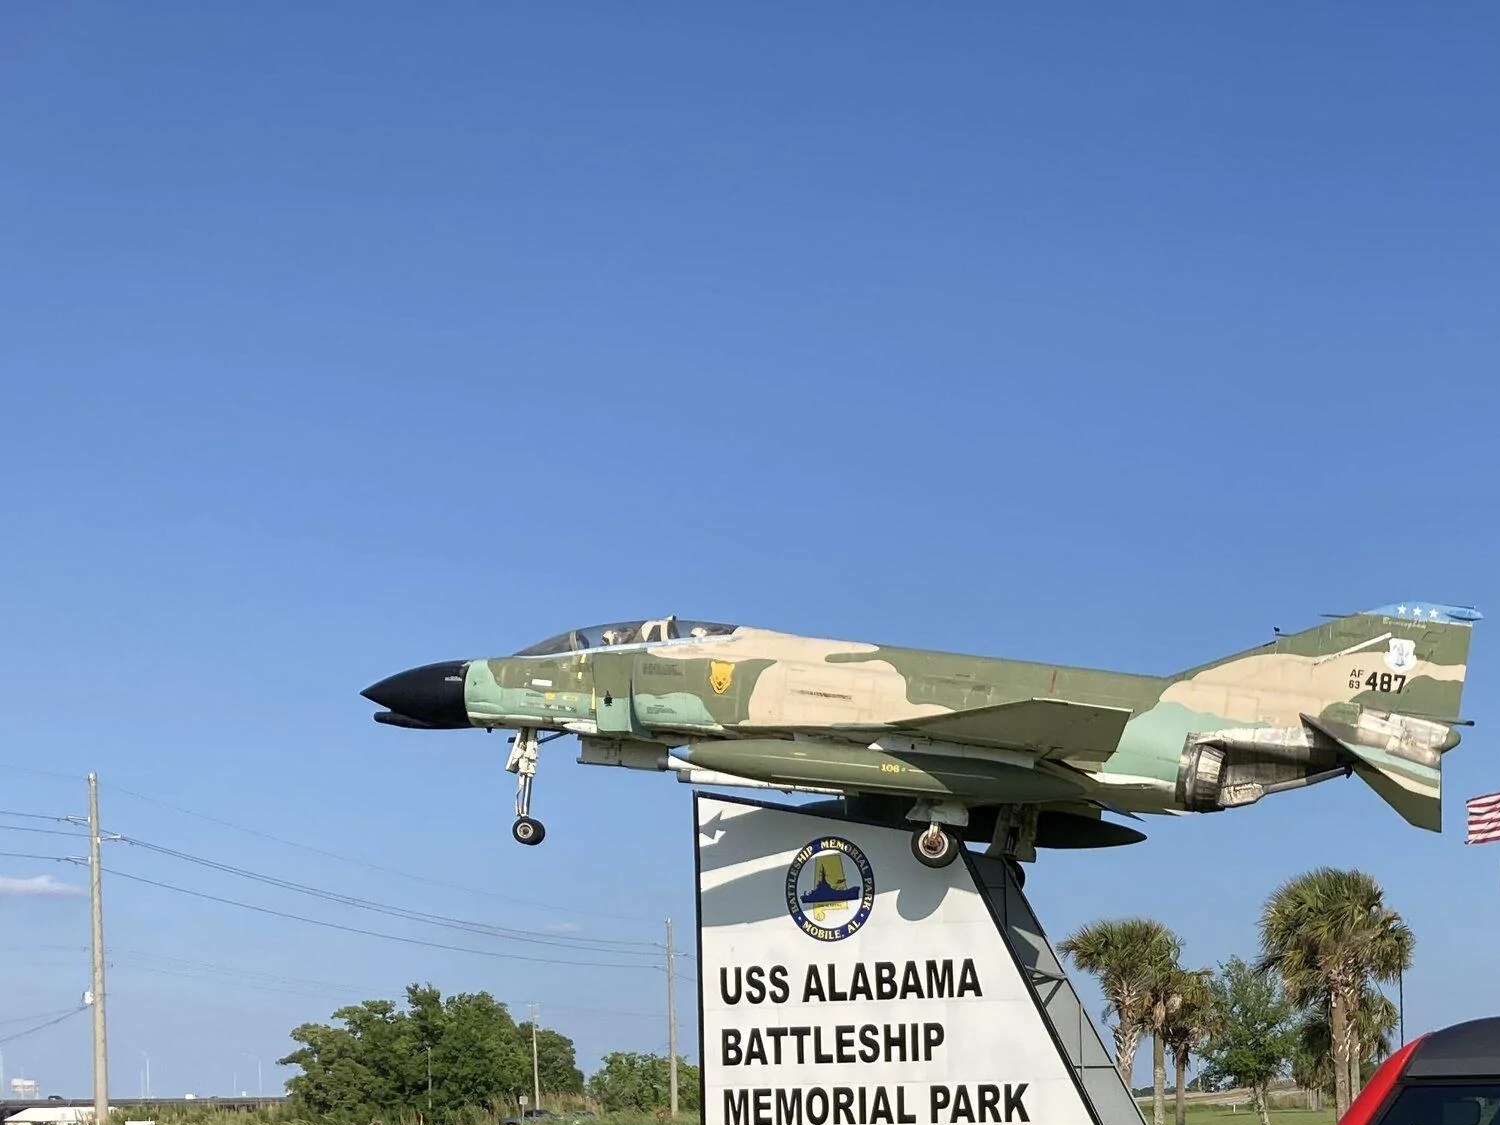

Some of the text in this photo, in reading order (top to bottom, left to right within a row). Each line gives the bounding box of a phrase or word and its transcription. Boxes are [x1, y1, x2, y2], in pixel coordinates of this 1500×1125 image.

[1348, 680, 1360, 690] 63
[1350, 669, 1364, 679] AF
[1365, 671, 1407, 695] 487
[787, 838, 875, 914] BATTLESHIP MEMORIAL PARK
[802, 919, 861, 940] MOBILE, AL
[719, 957, 983, 1006] USS ALABAMA
[720, 1022, 945, 1067] BATTLESHIP
[929, 1082, 1031, 1124] PARK
